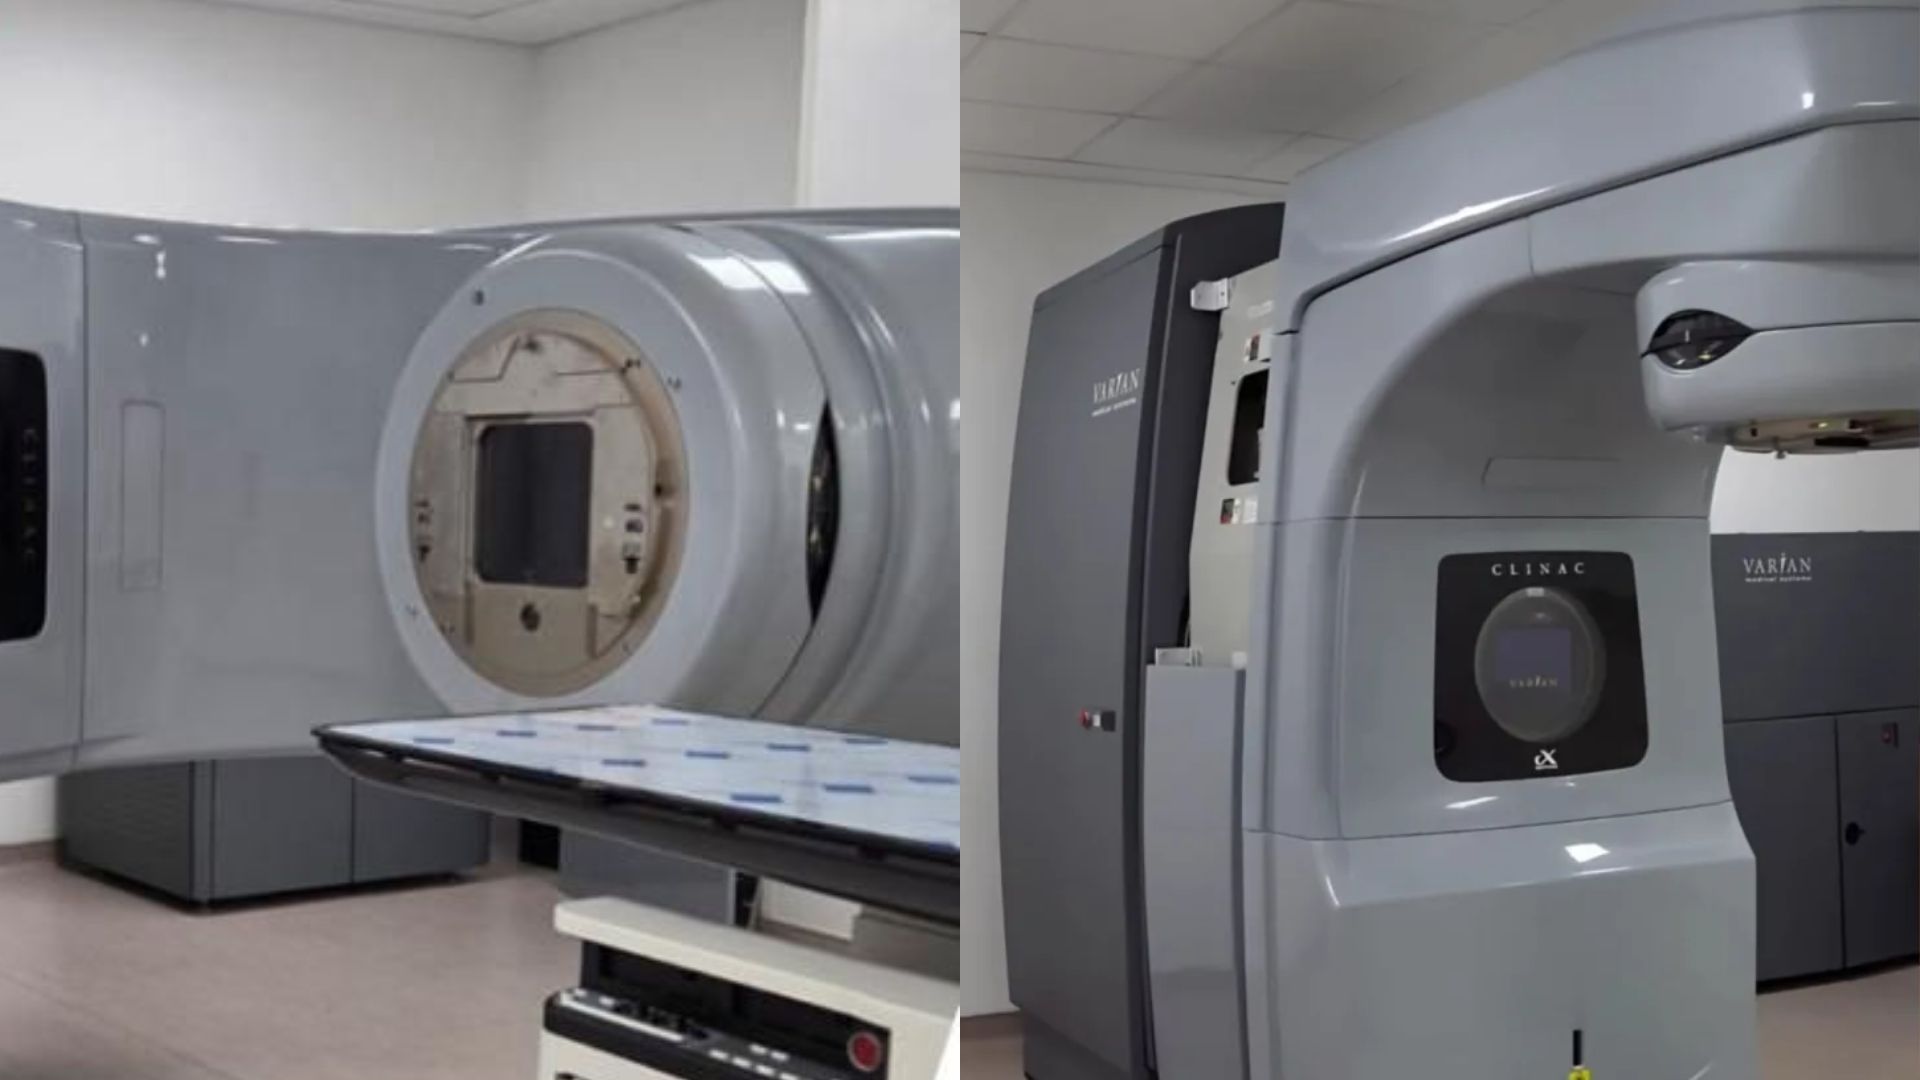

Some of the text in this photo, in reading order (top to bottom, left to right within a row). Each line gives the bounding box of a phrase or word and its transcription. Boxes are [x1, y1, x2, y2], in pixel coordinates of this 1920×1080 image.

[1093, 367, 1140, 403] VARIAN
[1491, 562, 1585, 576] CLINAC
[1742, 552, 1811, 574] VARIAN
